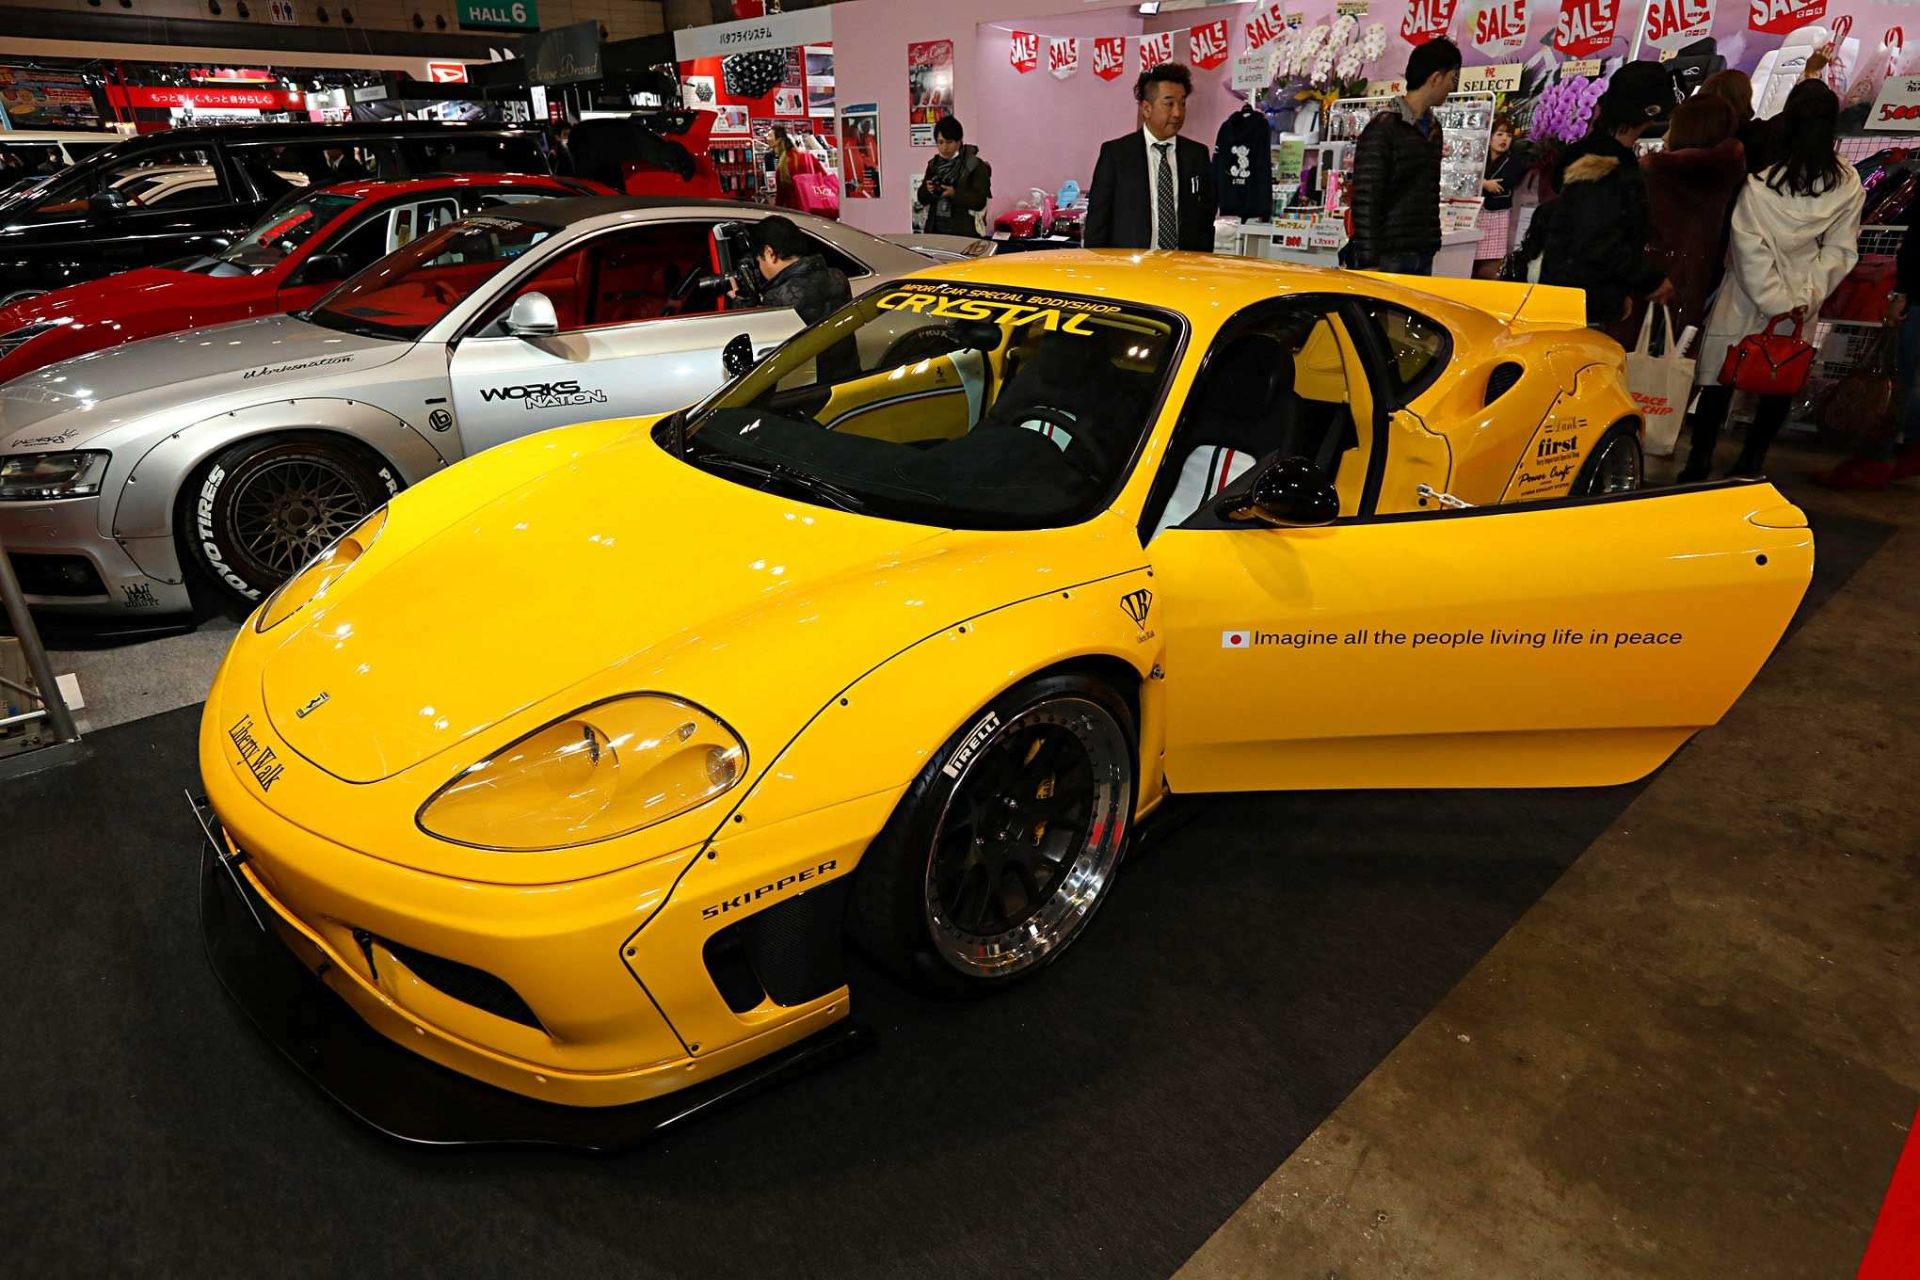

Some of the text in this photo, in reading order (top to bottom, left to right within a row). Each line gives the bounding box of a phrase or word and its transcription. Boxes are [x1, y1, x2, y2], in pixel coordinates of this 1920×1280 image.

[469, 3, 526, 23] HALL 6
[1246, 4, 1286, 50] SALE
[1476, 0, 1526, 44] SALE
[1010, 34, 1037, 65] SALE
[1049, 38, 1077, 71] SALE
[1093, 39, 1123, 74] SALE
[1140, 32, 1171, 72] SALE
[1190, 21, 1226, 64] SALE
[1463, 79, 1514, 92] SELECT
[876, 292, 1096, 337] CRYSTAL
[941, 287, 967, 298] CAR
[966, 289, 1023, 303] SPECIAL
[1027, 296, 1122, 314] BODYSHOP
[480, 380, 581, 402] WORKS
[1537, 435, 1577, 457] first
[197, 463, 263, 601] TOYO TIRES
[1254, 629, 1683, 648] Imagine all the people living life in peace
[228, 714, 285, 793] Liberty Walk
[942, 711, 1001, 780] PIRELLI
[702, 860, 837, 920] SKIPPER
